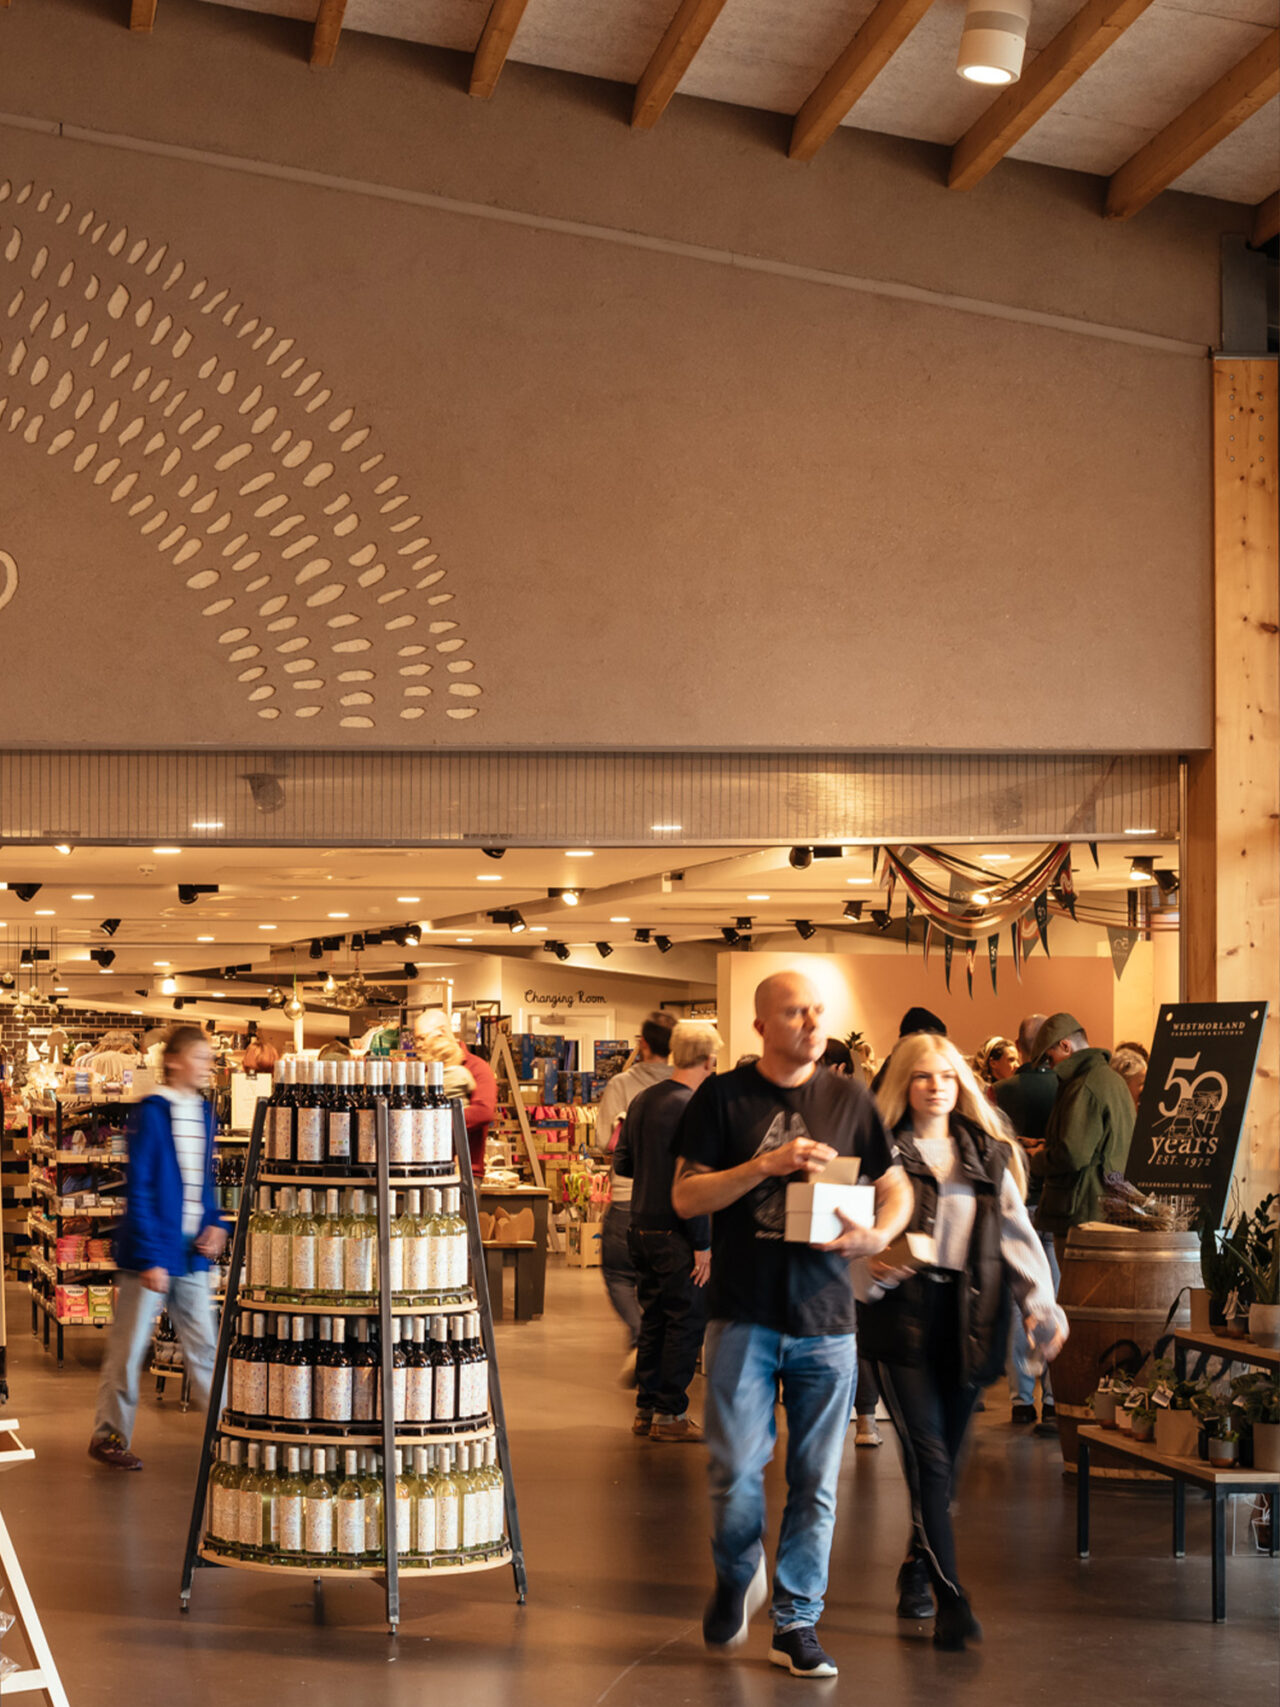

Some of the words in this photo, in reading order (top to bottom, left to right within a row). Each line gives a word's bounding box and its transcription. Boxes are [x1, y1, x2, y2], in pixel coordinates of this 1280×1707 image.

[524, 989, 574, 1008] Changing
[577, 989, 607, 1004] Room
[1172, 1021, 1246, 1031] WESTMORLAND
[1158, 1051, 1229, 1120] 50
[1147, 1135, 1219, 1165] years
[1155, 1154, 1179, 1166] EST.
[1184, 1157, 1212, 1168] 1972
